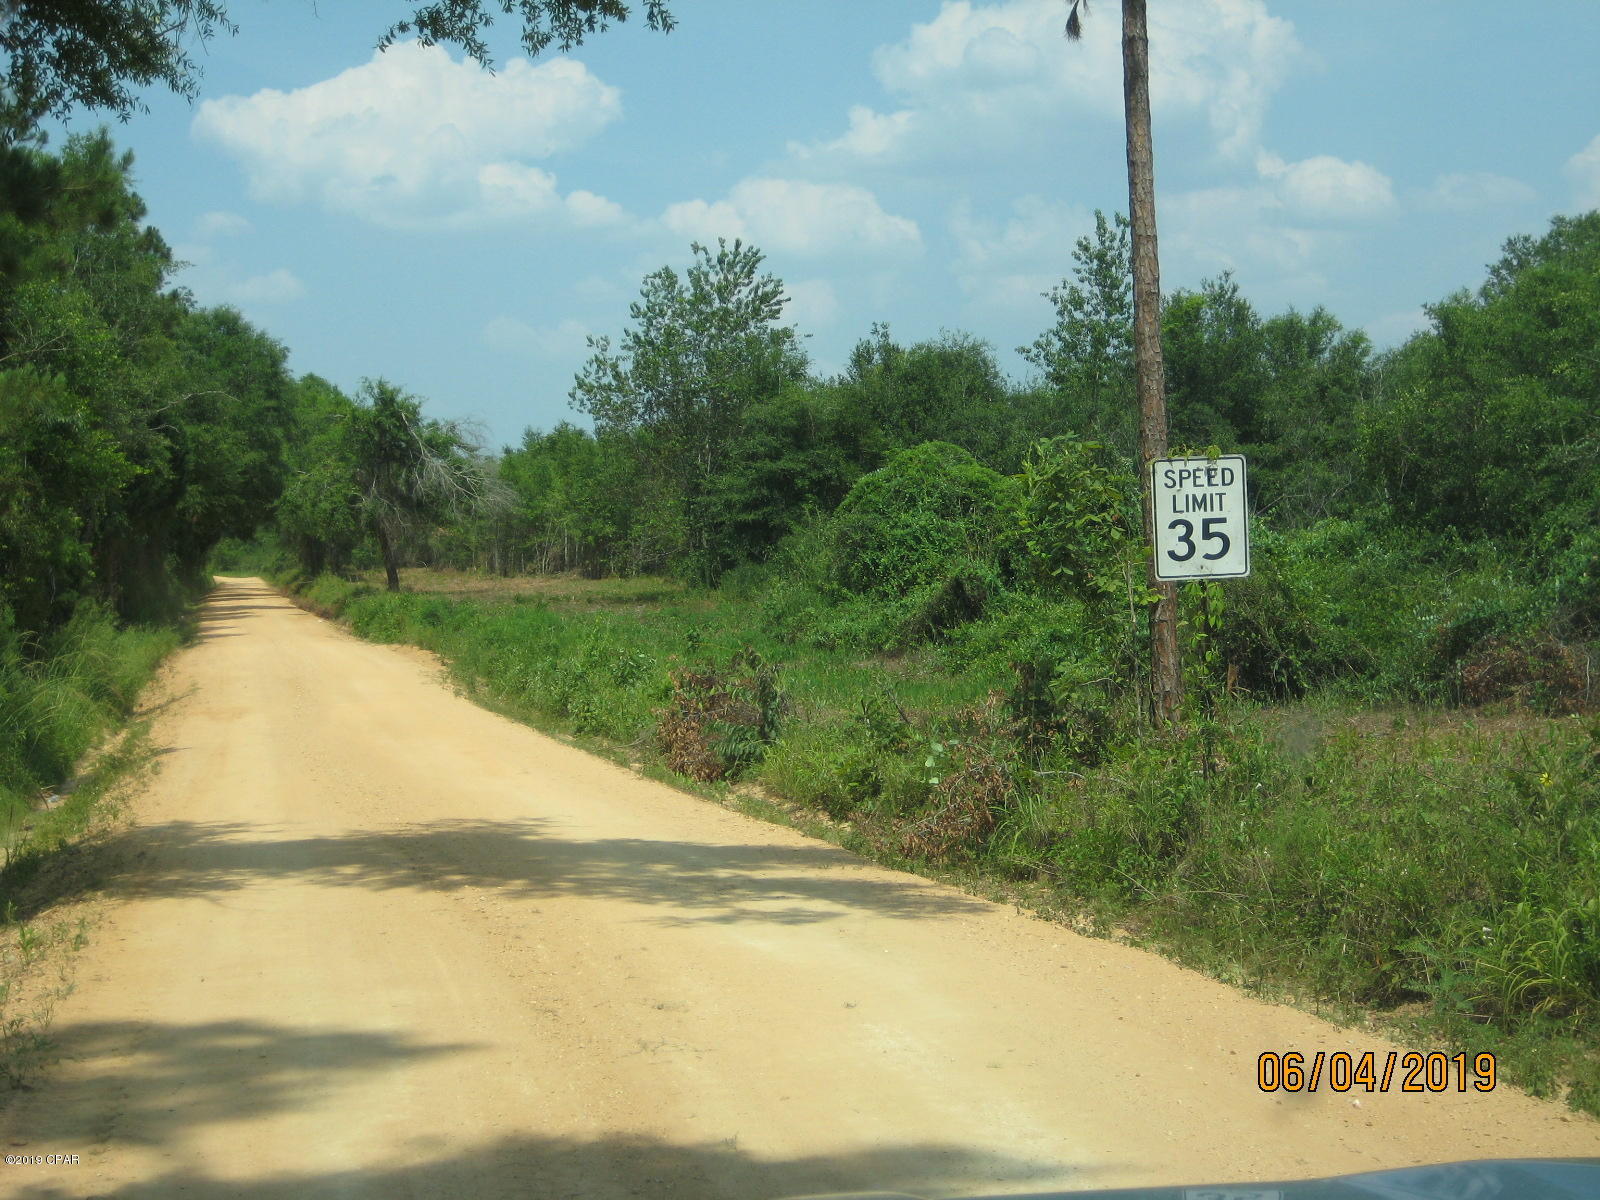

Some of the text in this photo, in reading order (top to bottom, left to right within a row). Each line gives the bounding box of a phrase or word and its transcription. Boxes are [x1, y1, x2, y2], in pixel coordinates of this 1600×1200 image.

[1163, 466, 1235, 489] SPEED
[1172, 492, 1227, 514] LIMIT
[1167, 517, 1231, 562] 35
